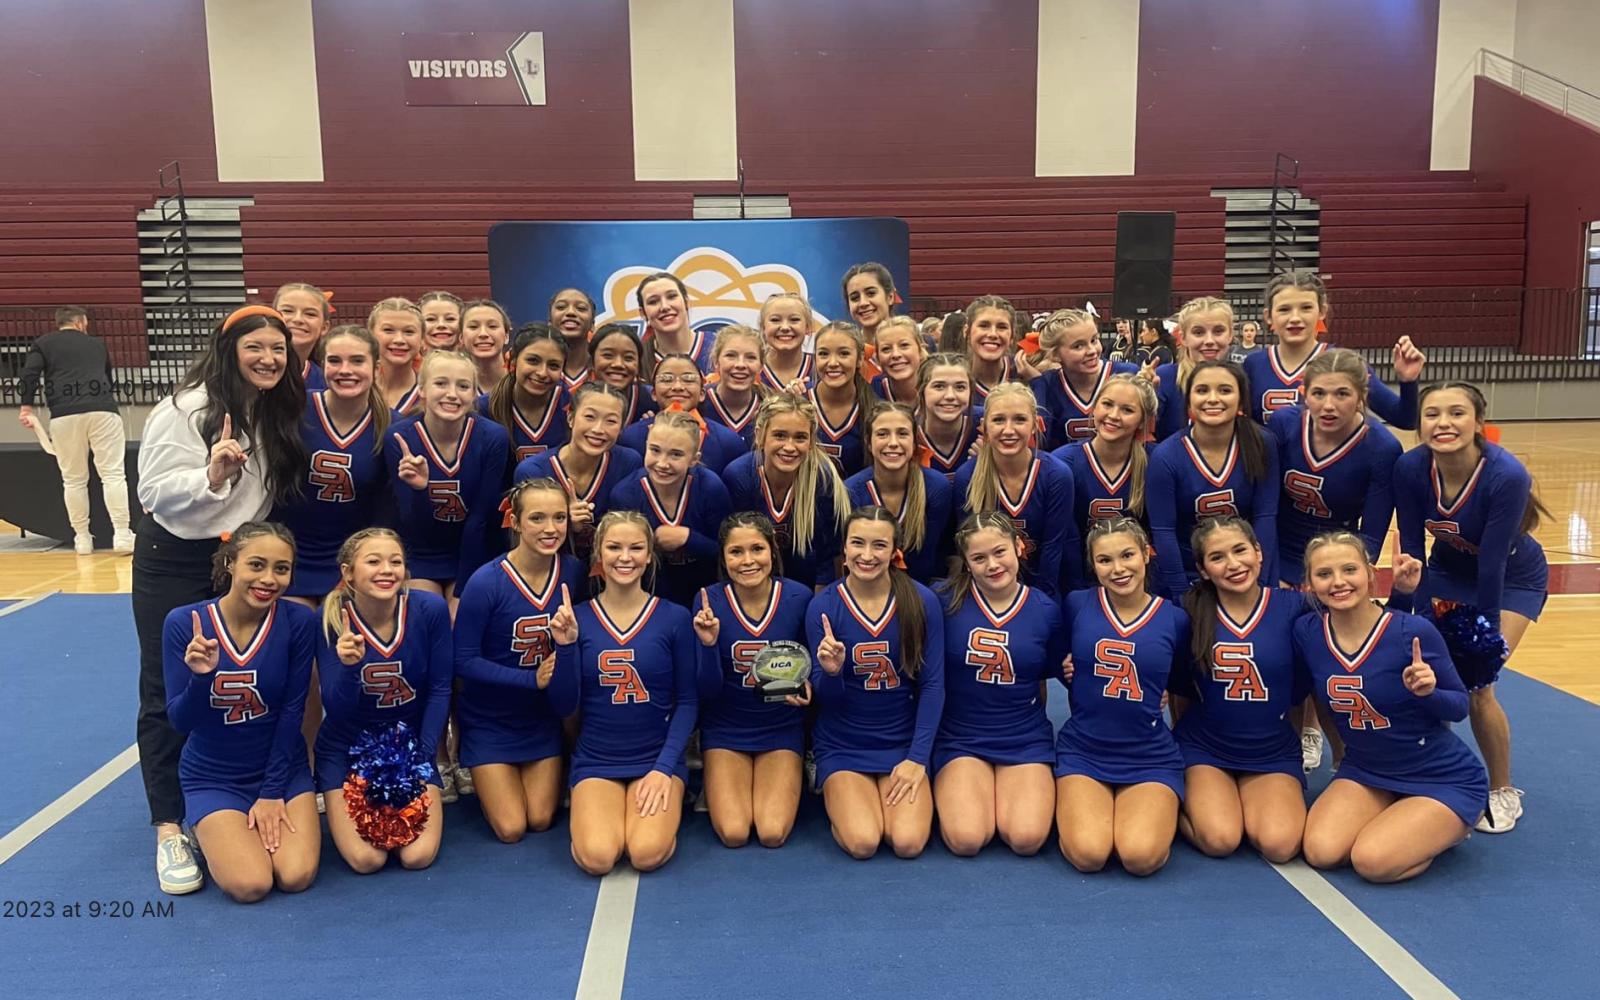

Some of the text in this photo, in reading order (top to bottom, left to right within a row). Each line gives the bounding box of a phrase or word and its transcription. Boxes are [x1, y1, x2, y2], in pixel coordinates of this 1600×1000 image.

[408, 59, 507, 78] VISITORS
[309, 449, 356, 502] SA
[428, 479, 468, 522] SA
[1284, 469, 1332, 519] SA
[510, 613, 558, 667] SA
[770, 661, 792, 669] UCA
[853, 640, 901, 691] SA
[965, 626, 1016, 685] SA
[360, 660, 416, 709] SA
[598, 648, 650, 705] SA
[1094, 638, 1143, 702] SA
[1212, 641, 1268, 702] SA
[210, 669, 269, 726] SA
[1326, 674, 1391, 730] SA
